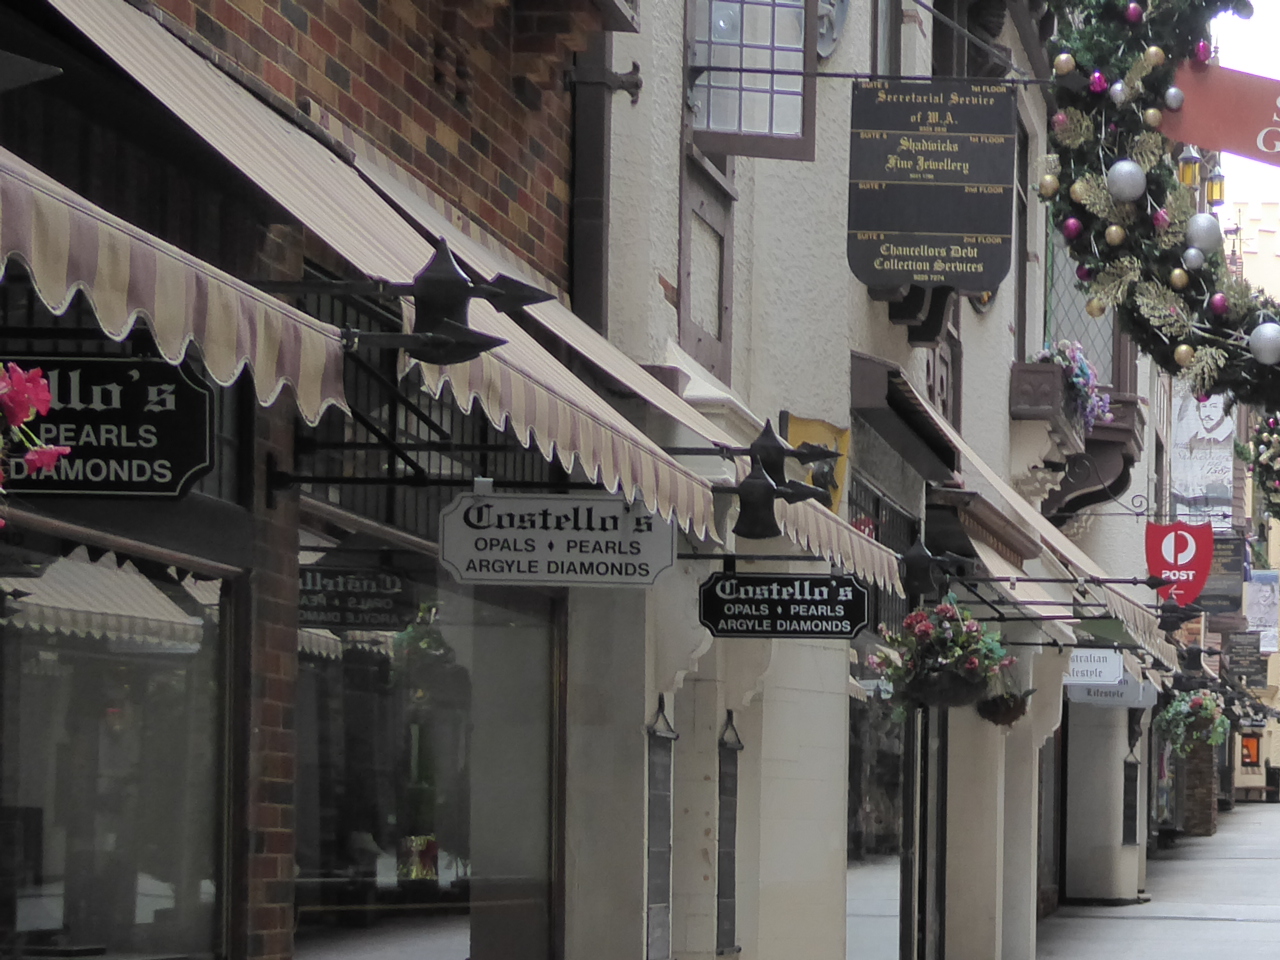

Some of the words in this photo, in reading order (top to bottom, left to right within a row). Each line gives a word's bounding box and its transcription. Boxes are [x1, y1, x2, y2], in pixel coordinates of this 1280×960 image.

[876, 89, 944, 104] Secretarial
[948, 92, 995, 105] Service
[982, 85, 1006, 93] FLOOR
[910, 112, 922, 123] of
[897, 136, 959, 153] Shadwicks
[885, 155, 913, 172] Fine
[916, 156, 969, 175] Jewellery
[880, 243, 947, 257] Chancellors
[950, 245, 978, 258] Debt
[873, 258, 930, 271] Collection
[933, 260, 984, 273] Services
[39, 423, 158, 448] PEARLS
[9, 457, 173, 483] DAMONDS
[463, 501, 654, 533] Costello's
[474, 537, 536, 552] OPALS
[566, 539, 642, 556] PEARLS
[465, 558, 539, 575] ARGYLE
[546, 560, 650, 577] DIAMONDS
[1161, 570, 1196, 580] POST
[715, 579, 853, 601] Costello's
[724, 603, 769, 616] OPALS
[790, 604, 845, 617] PEARLS
[717, 619, 772, 632] ARGYLE
[776, 619, 851, 632] DIAMONDS
[1086, 688, 1125, 698] Lifestyle
